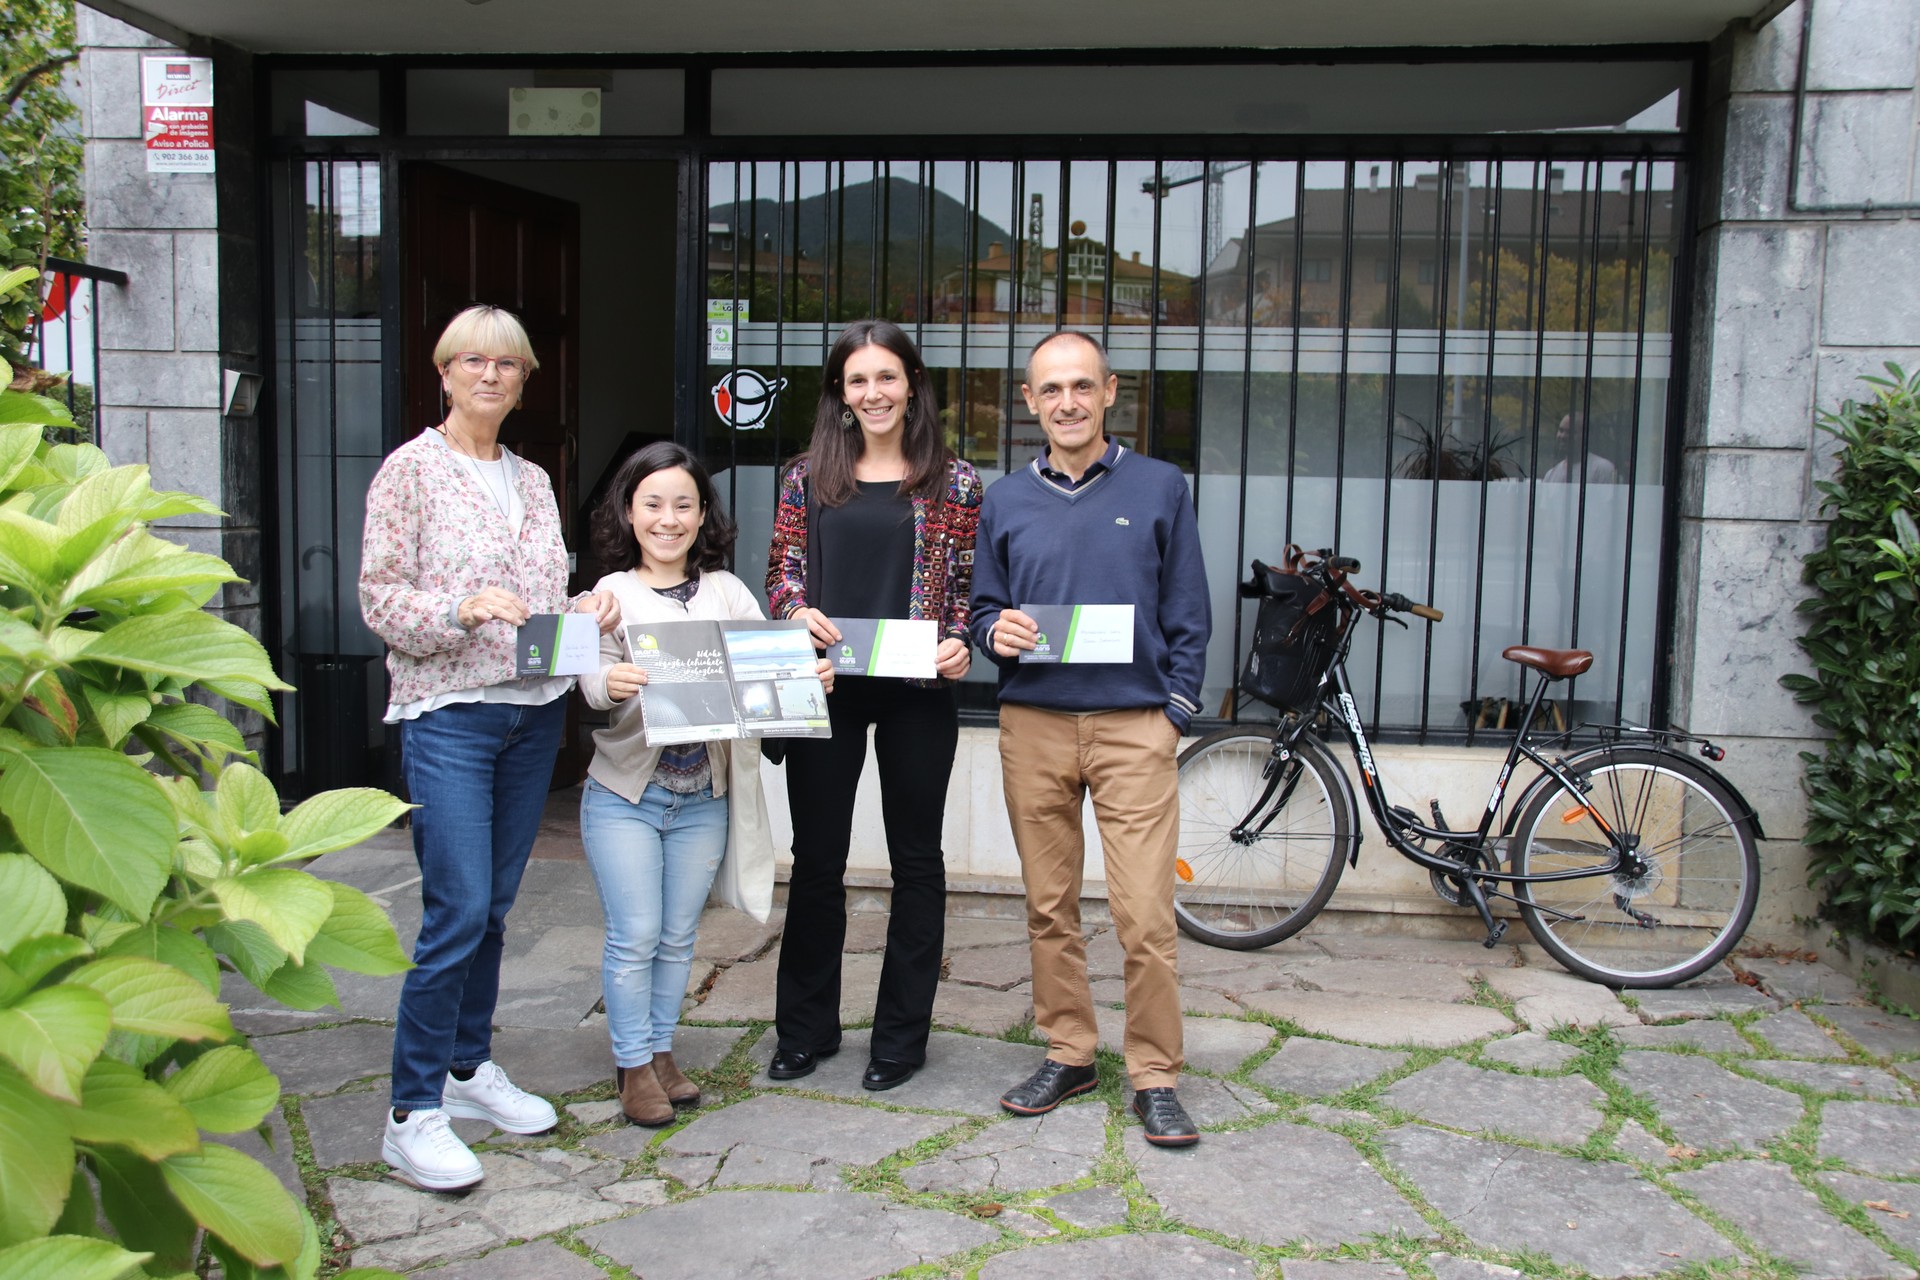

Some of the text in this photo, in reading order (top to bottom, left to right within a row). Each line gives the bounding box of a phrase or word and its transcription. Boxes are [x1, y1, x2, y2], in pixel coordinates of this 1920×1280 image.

[156, 80, 202, 99] Direct
[151, 107, 208, 120] Alarma
[153, 140, 175, 148] Aviso
[162, 153, 209, 161] 902 366 366
[1341, 691, 1376, 777] megamo
